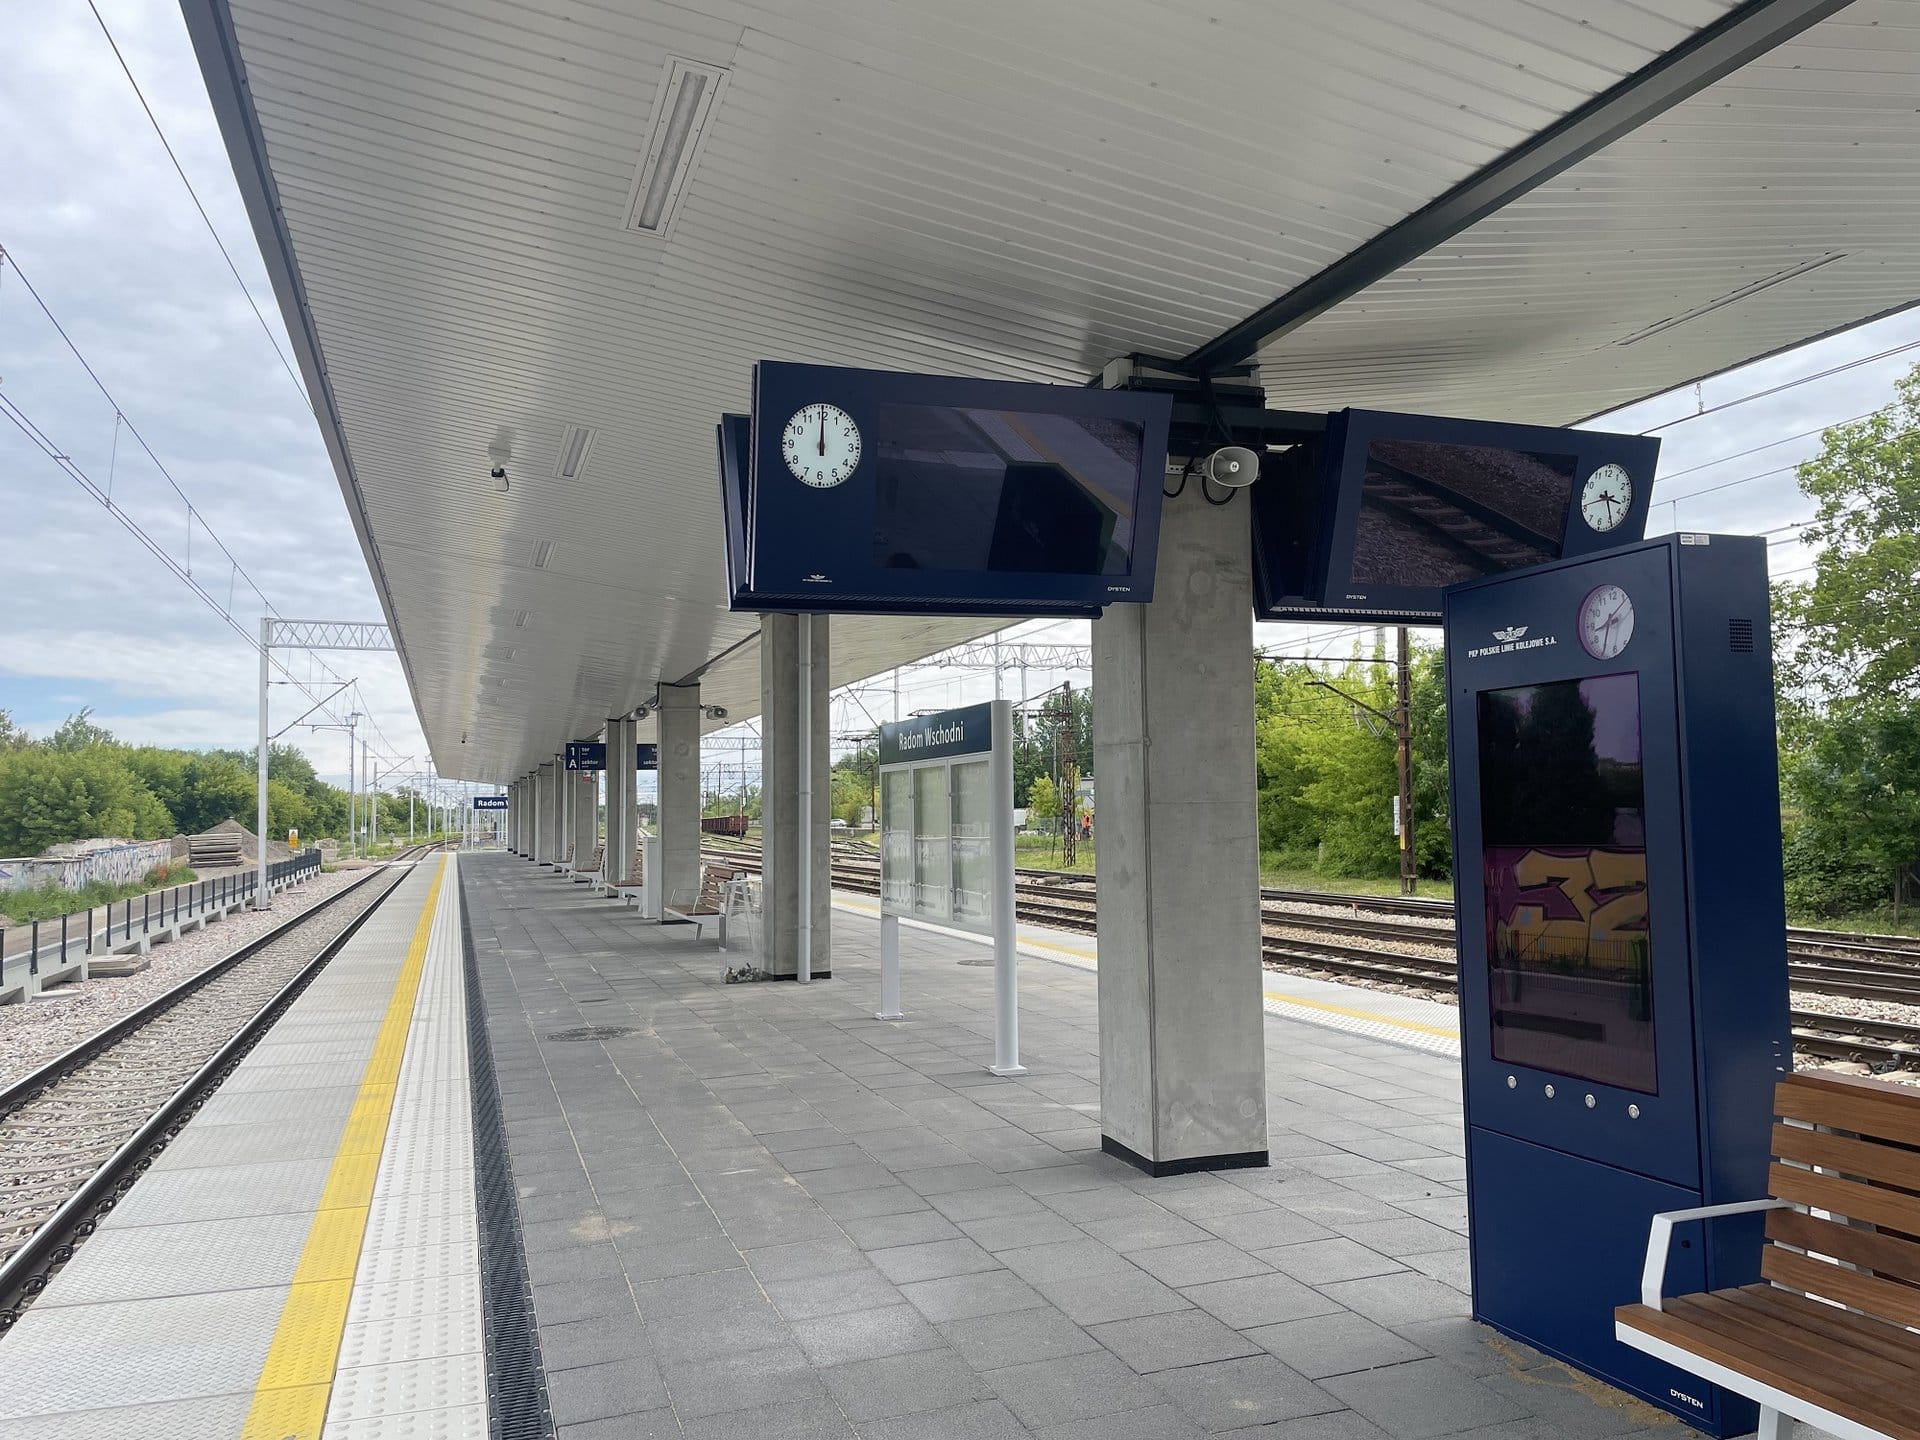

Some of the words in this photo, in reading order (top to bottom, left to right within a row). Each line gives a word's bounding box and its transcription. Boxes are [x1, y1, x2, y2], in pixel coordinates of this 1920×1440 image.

[803, 414, 813, 423] 11
[817, 411, 828, 421] 12
[834, 417, 838, 425] 1
[791, 426, 804, 435] 10
[844, 428, 850, 437] 2
[788, 439, 794, 449] 9
[848, 443, 854, 452] 3
[792, 455, 799, 464] 8
[842, 459, 848, 467] 4
[803, 467, 809, 475] 7
[817, 471, 823, 480] 6
[831, 468, 838, 477] 5
[1586, 481, 1594, 489] 10
[1622, 495, 1626, 503] 3
[1583, 505, 1587, 513] 8
[1608, 592, 1617, 600] 12
[1599, 598, 1606, 606] 11
[1593, 609, 1600, 617] 10
[1594, 635, 1599, 643] 8
[1468, 649, 1478, 657] PKP
[1480, 646, 1500, 656] POLSKIE
[1501, 643, 1514, 653] LINIE
[1516, 638, 1544, 650] KOLEJOWE
[1545, 636, 1557, 645] S.A.
[1613, 645, 1617, 653] 6
[899, 730, 923, 751] Radom
[924, 720, 964, 747] Wschodni
[570, 747, 575, 756] 1
[569, 759, 577, 768] A
[1670, 1388, 1703, 1408] DYSTEN
